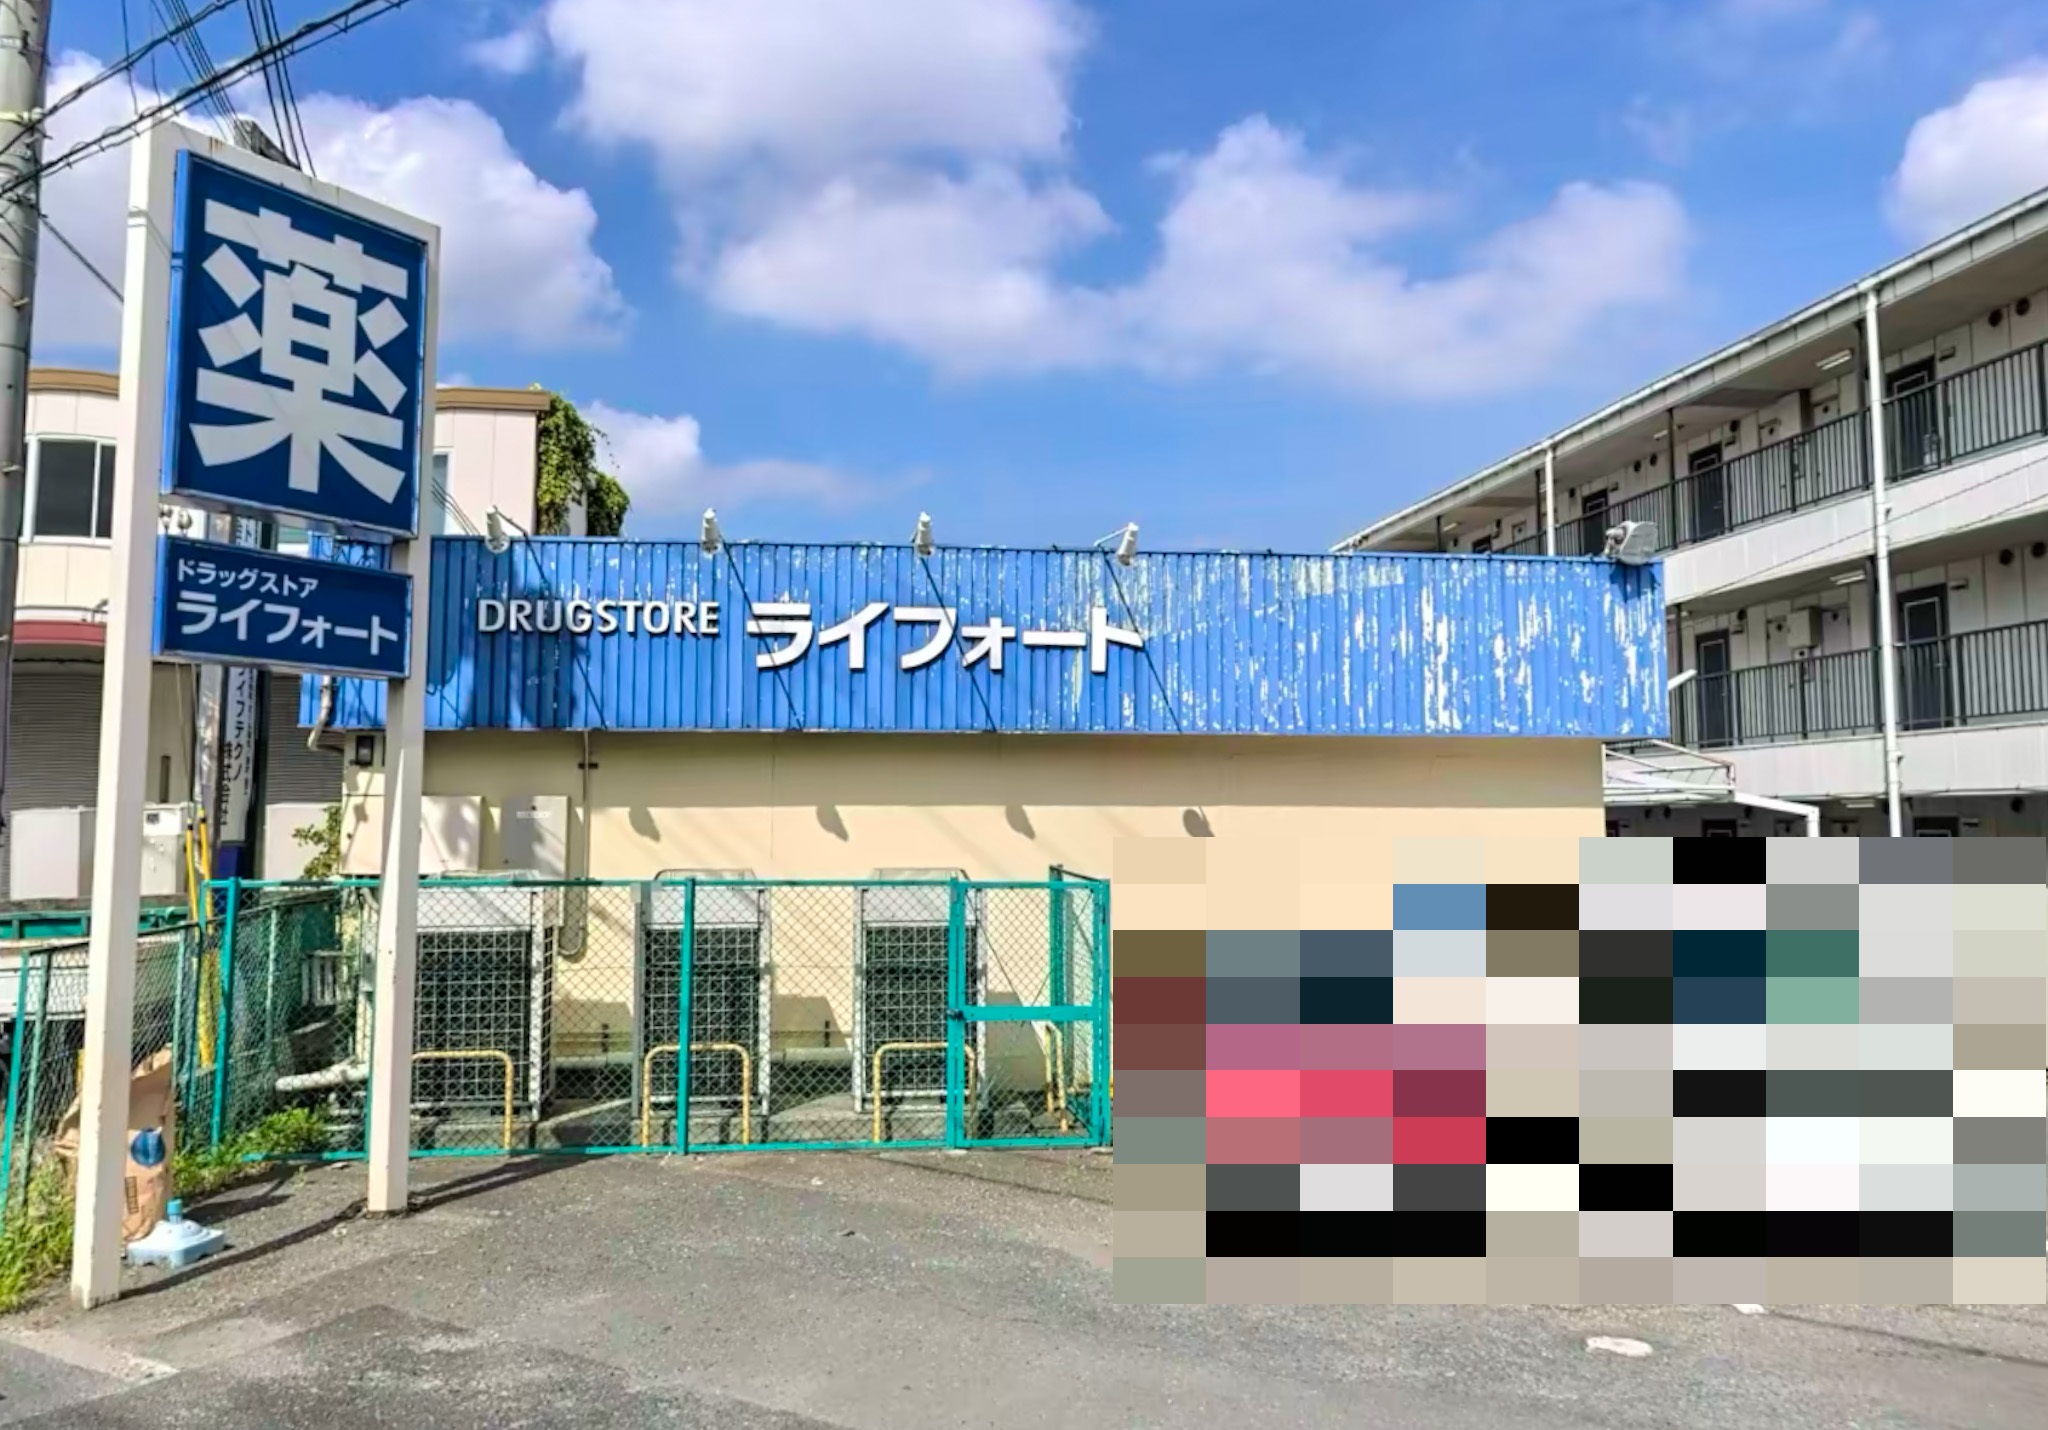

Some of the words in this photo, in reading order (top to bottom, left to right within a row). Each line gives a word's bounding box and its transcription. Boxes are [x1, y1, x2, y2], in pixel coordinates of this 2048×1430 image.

[189, 199, 409, 504] 薬
[177, 558, 319, 599] ドラッグストア
[176, 590, 399, 657] ライフォート
[477, 598, 721, 637] DRUGSTORE
[746, 602, 1145, 674] ライフォート
